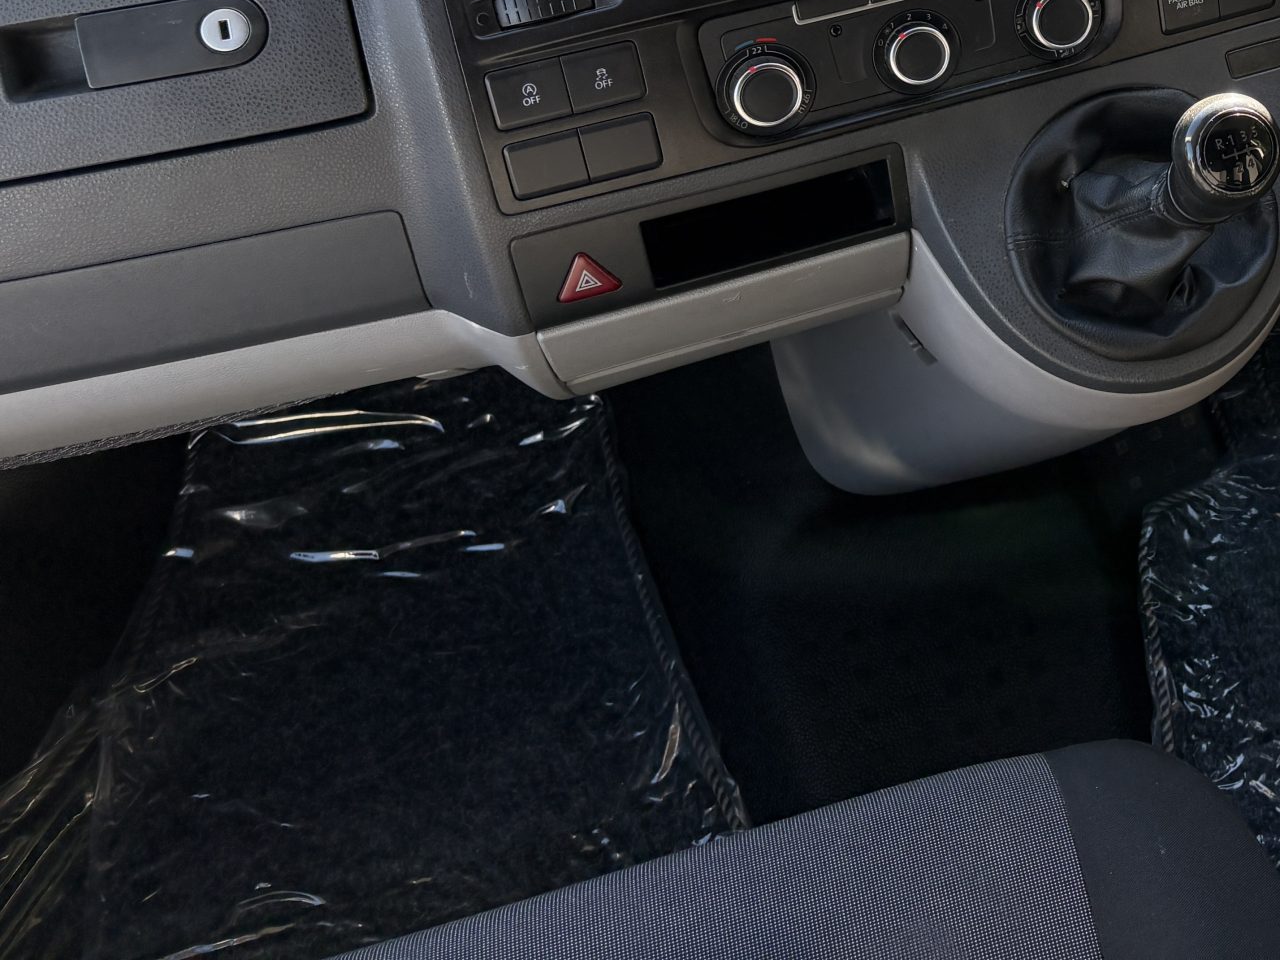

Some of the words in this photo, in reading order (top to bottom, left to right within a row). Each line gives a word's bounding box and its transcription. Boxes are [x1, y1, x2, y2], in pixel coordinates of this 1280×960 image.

[1176, 0, 1188, 10] AIR
[751, 46, 762, 55] 22
[595, 78, 613, 90] OFF
[522, 95, 541, 107] OFF
[1215, 138, 1225, 150] R
[1228, 134, 1235, 146] 1
[1240, 130, 1248, 141] 3
